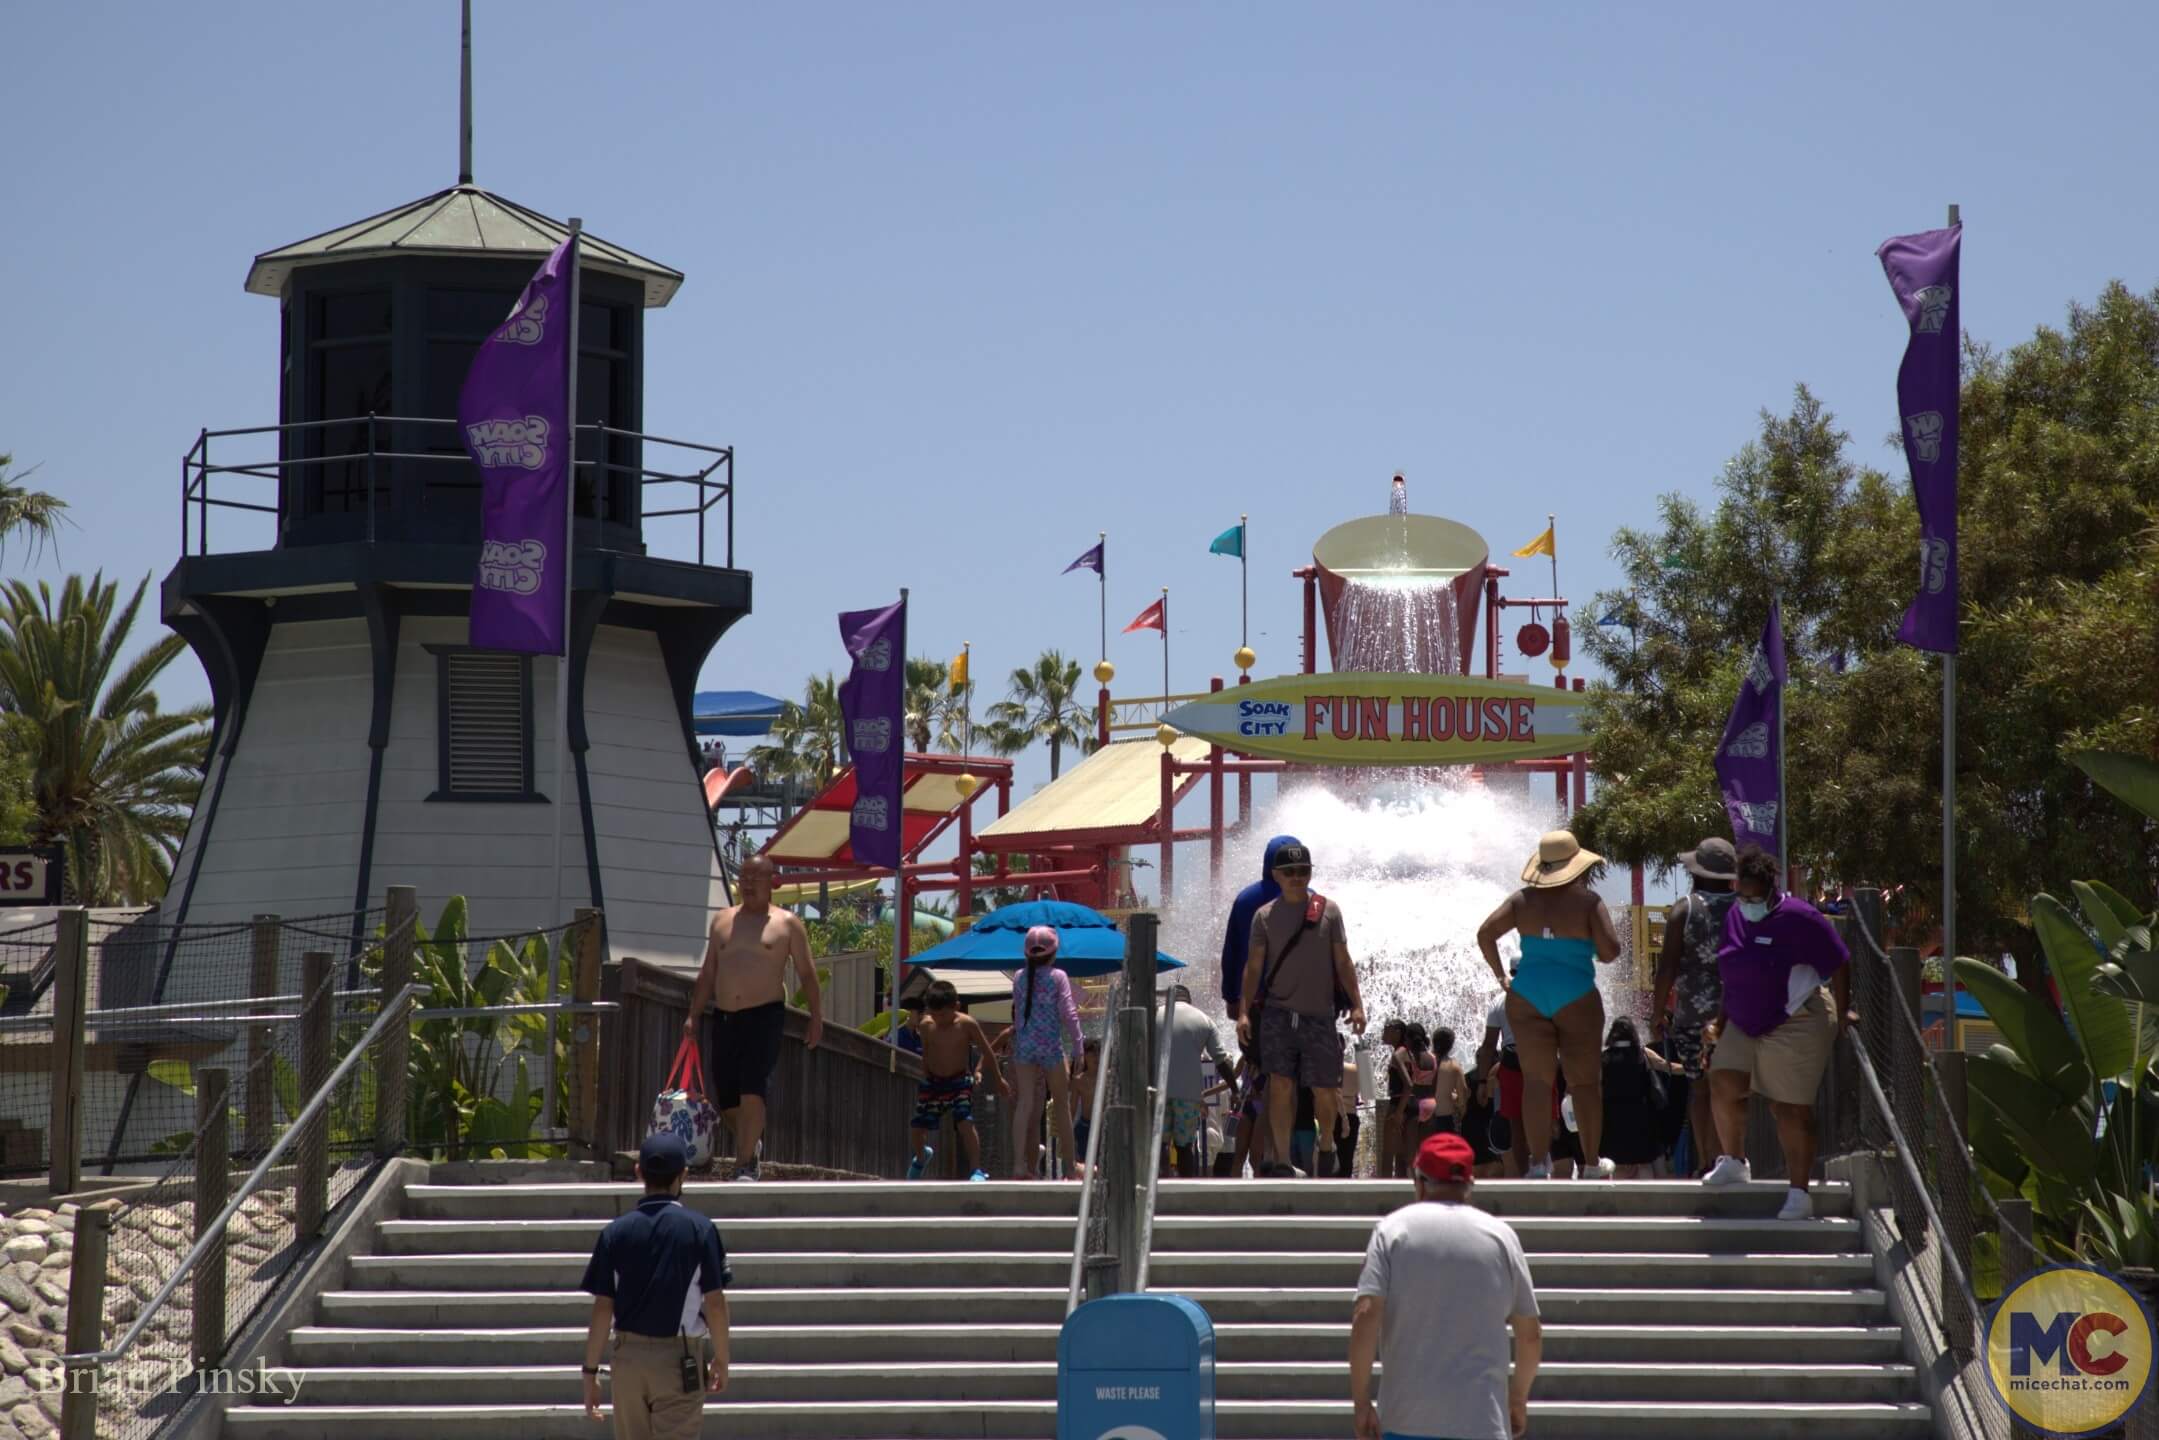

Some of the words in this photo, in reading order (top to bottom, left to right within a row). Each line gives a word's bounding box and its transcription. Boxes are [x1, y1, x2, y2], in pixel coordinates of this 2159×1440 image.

[1239, 700, 1290, 717] SOAK
[1303, 696, 1391, 741] FUN
[1401, 696, 1536, 743] HOUSE
[1240, 721, 1285, 736] CITY
[1096, 1386, 1126, 1400] WASTE
[1128, 1386, 1160, 1400] PLEASE
